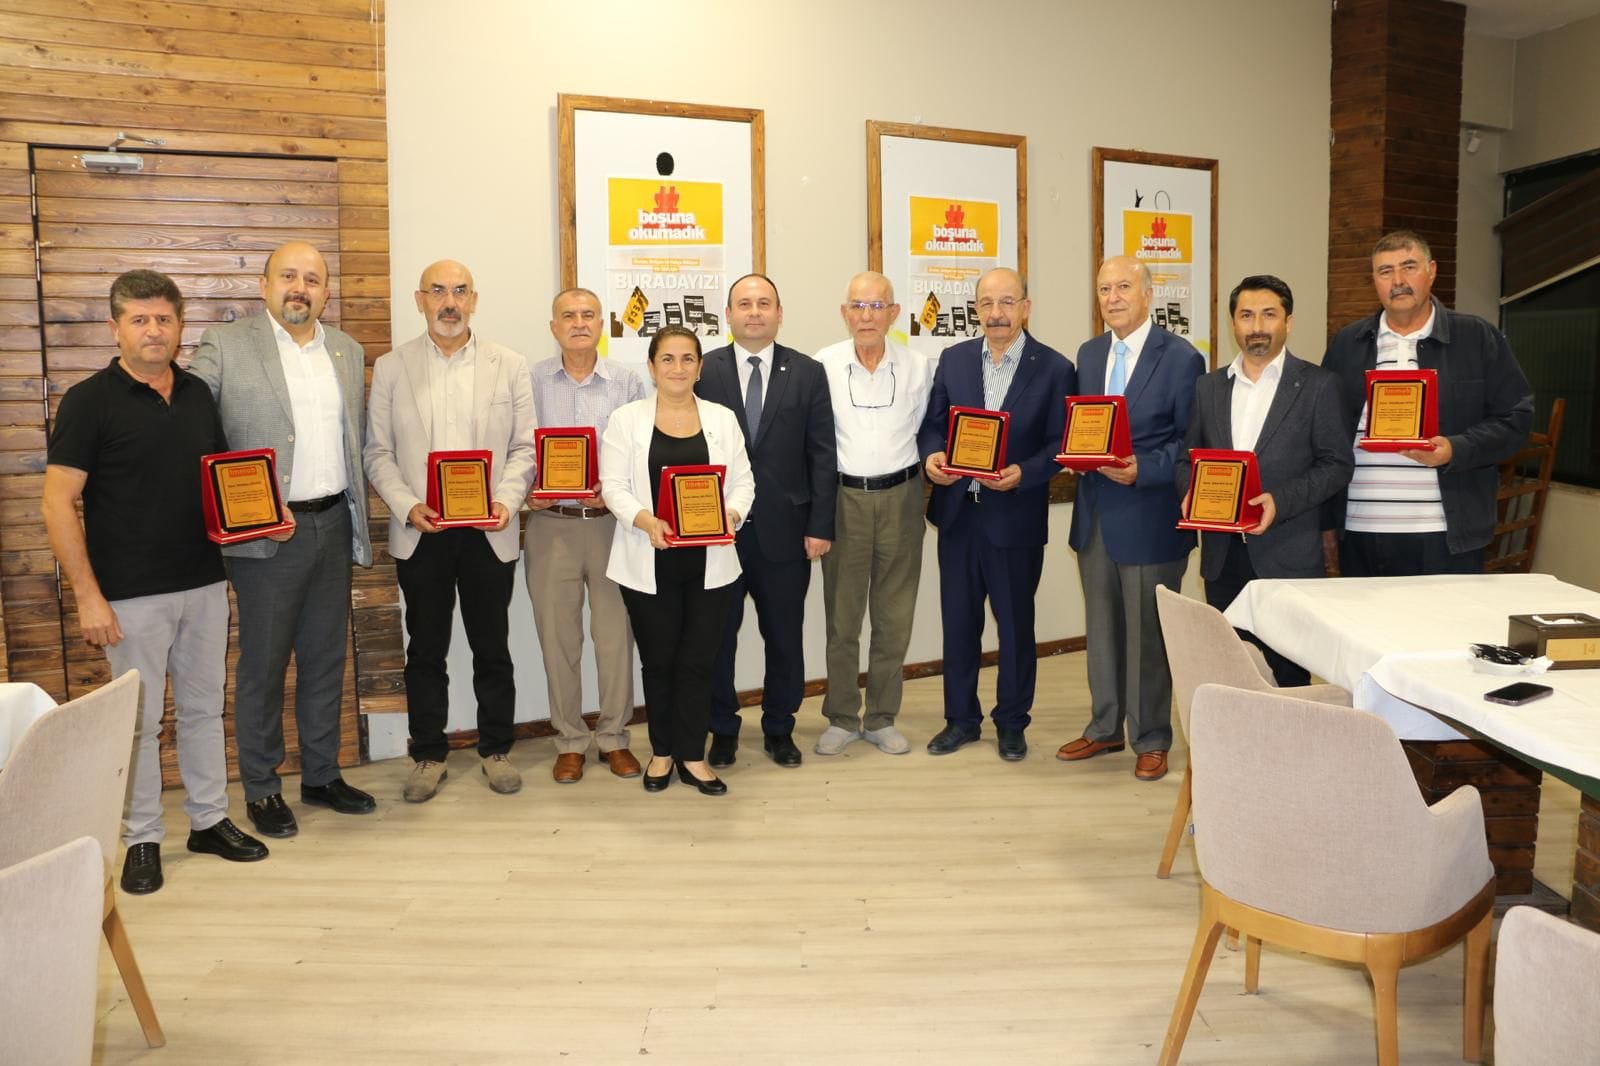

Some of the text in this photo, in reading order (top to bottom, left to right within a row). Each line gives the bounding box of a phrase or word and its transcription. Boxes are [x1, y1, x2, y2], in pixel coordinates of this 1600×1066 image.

[638, 209, 695, 228] boşuna
[628, 225, 705, 240] okumadık
[933, 224, 977, 240] boşuna
[925, 238, 984, 252] okumadık
[615, 272, 720, 289] BURADAYIZ!
[914, 279, 976, 296] BURADAY
[1152, 285, 1190, 299] DAYIZ!
